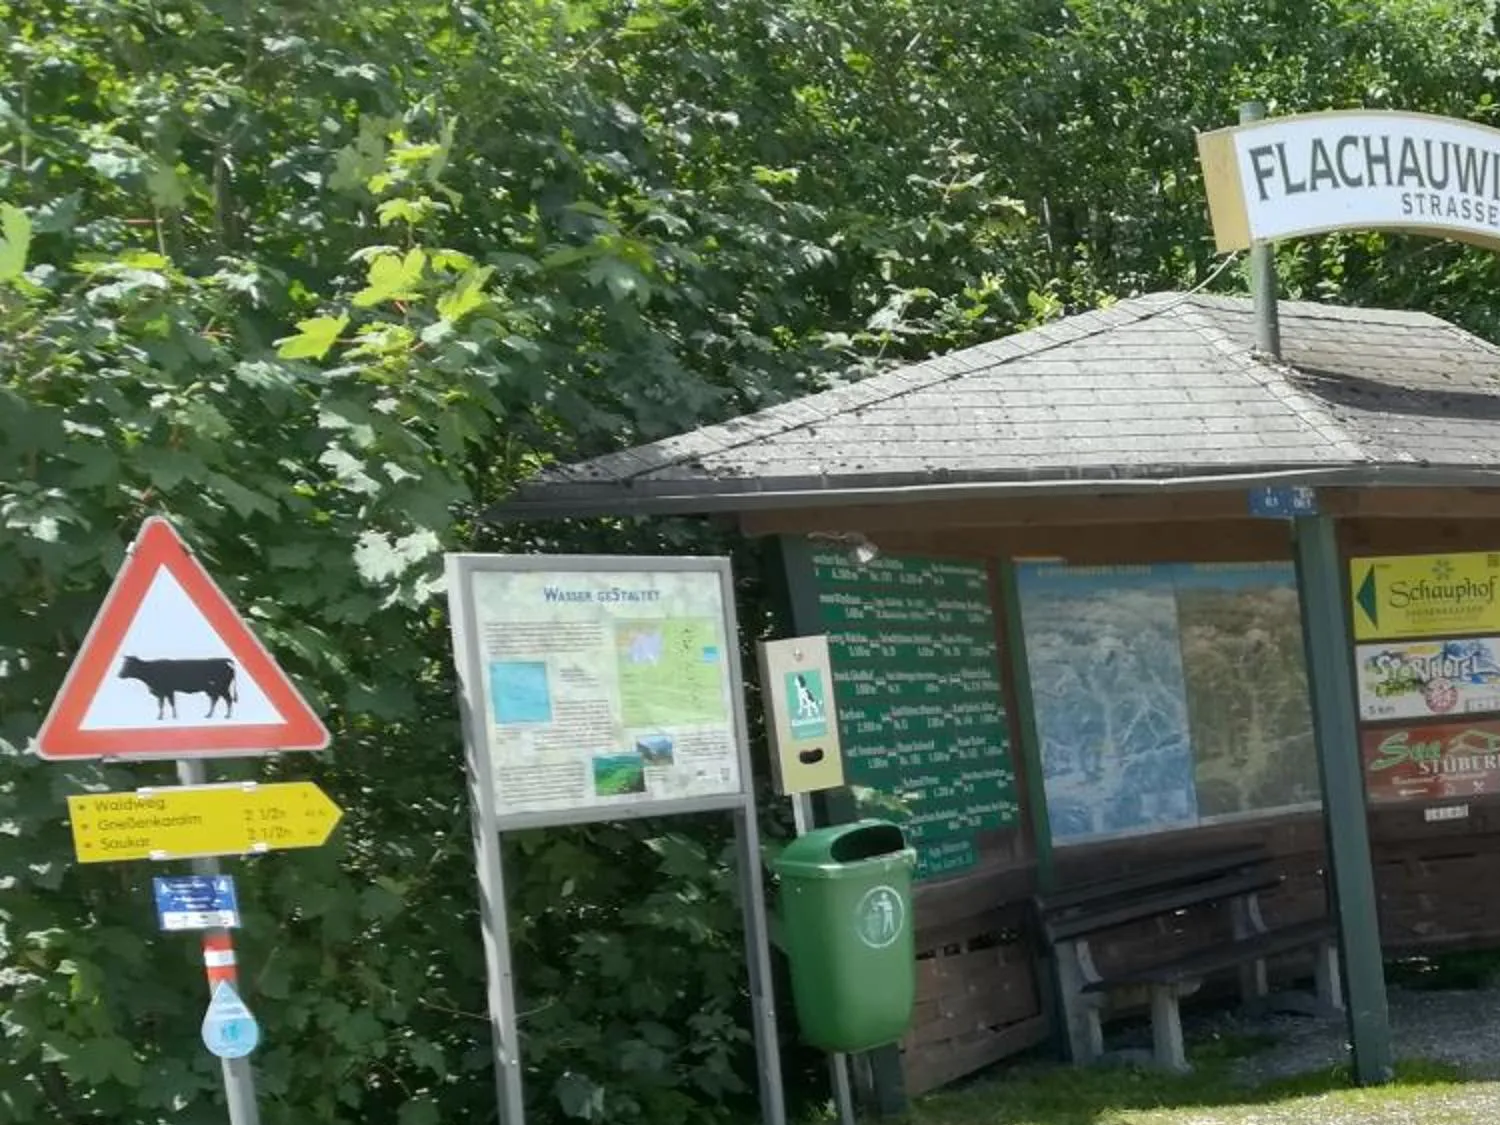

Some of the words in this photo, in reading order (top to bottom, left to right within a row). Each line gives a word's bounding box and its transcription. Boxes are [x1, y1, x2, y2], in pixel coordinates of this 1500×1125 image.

[1401, 192, 1500, 227] STRASSE
[1390, 575, 1499, 609] Schauphof
[94, 799, 165, 812] Waldweg
